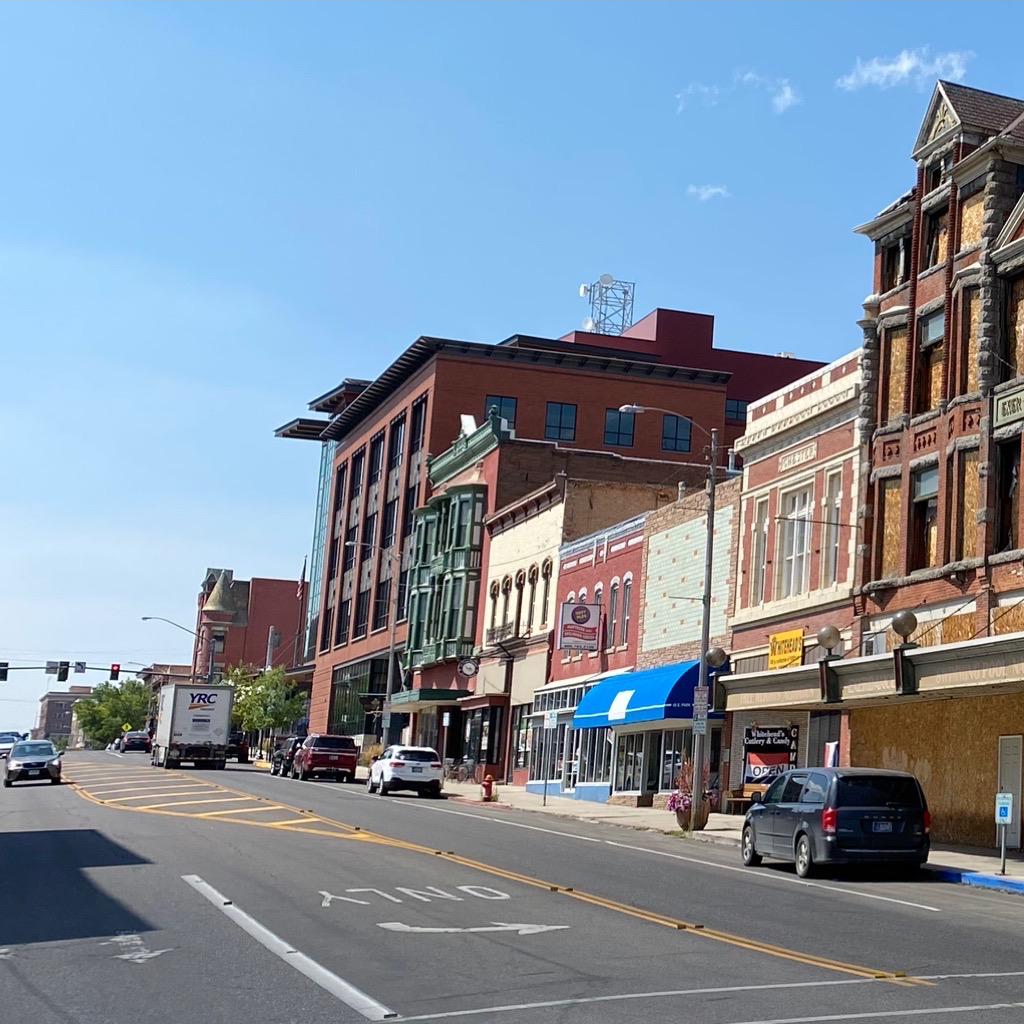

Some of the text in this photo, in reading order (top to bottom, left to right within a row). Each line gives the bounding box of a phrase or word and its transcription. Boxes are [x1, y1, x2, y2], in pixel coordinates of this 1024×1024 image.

[189, 693, 217, 703] YRC
[772, 737, 790, 745] Candy
[752, 764, 785, 777] OPEN
[318, 885, 510, 907] ONLY
